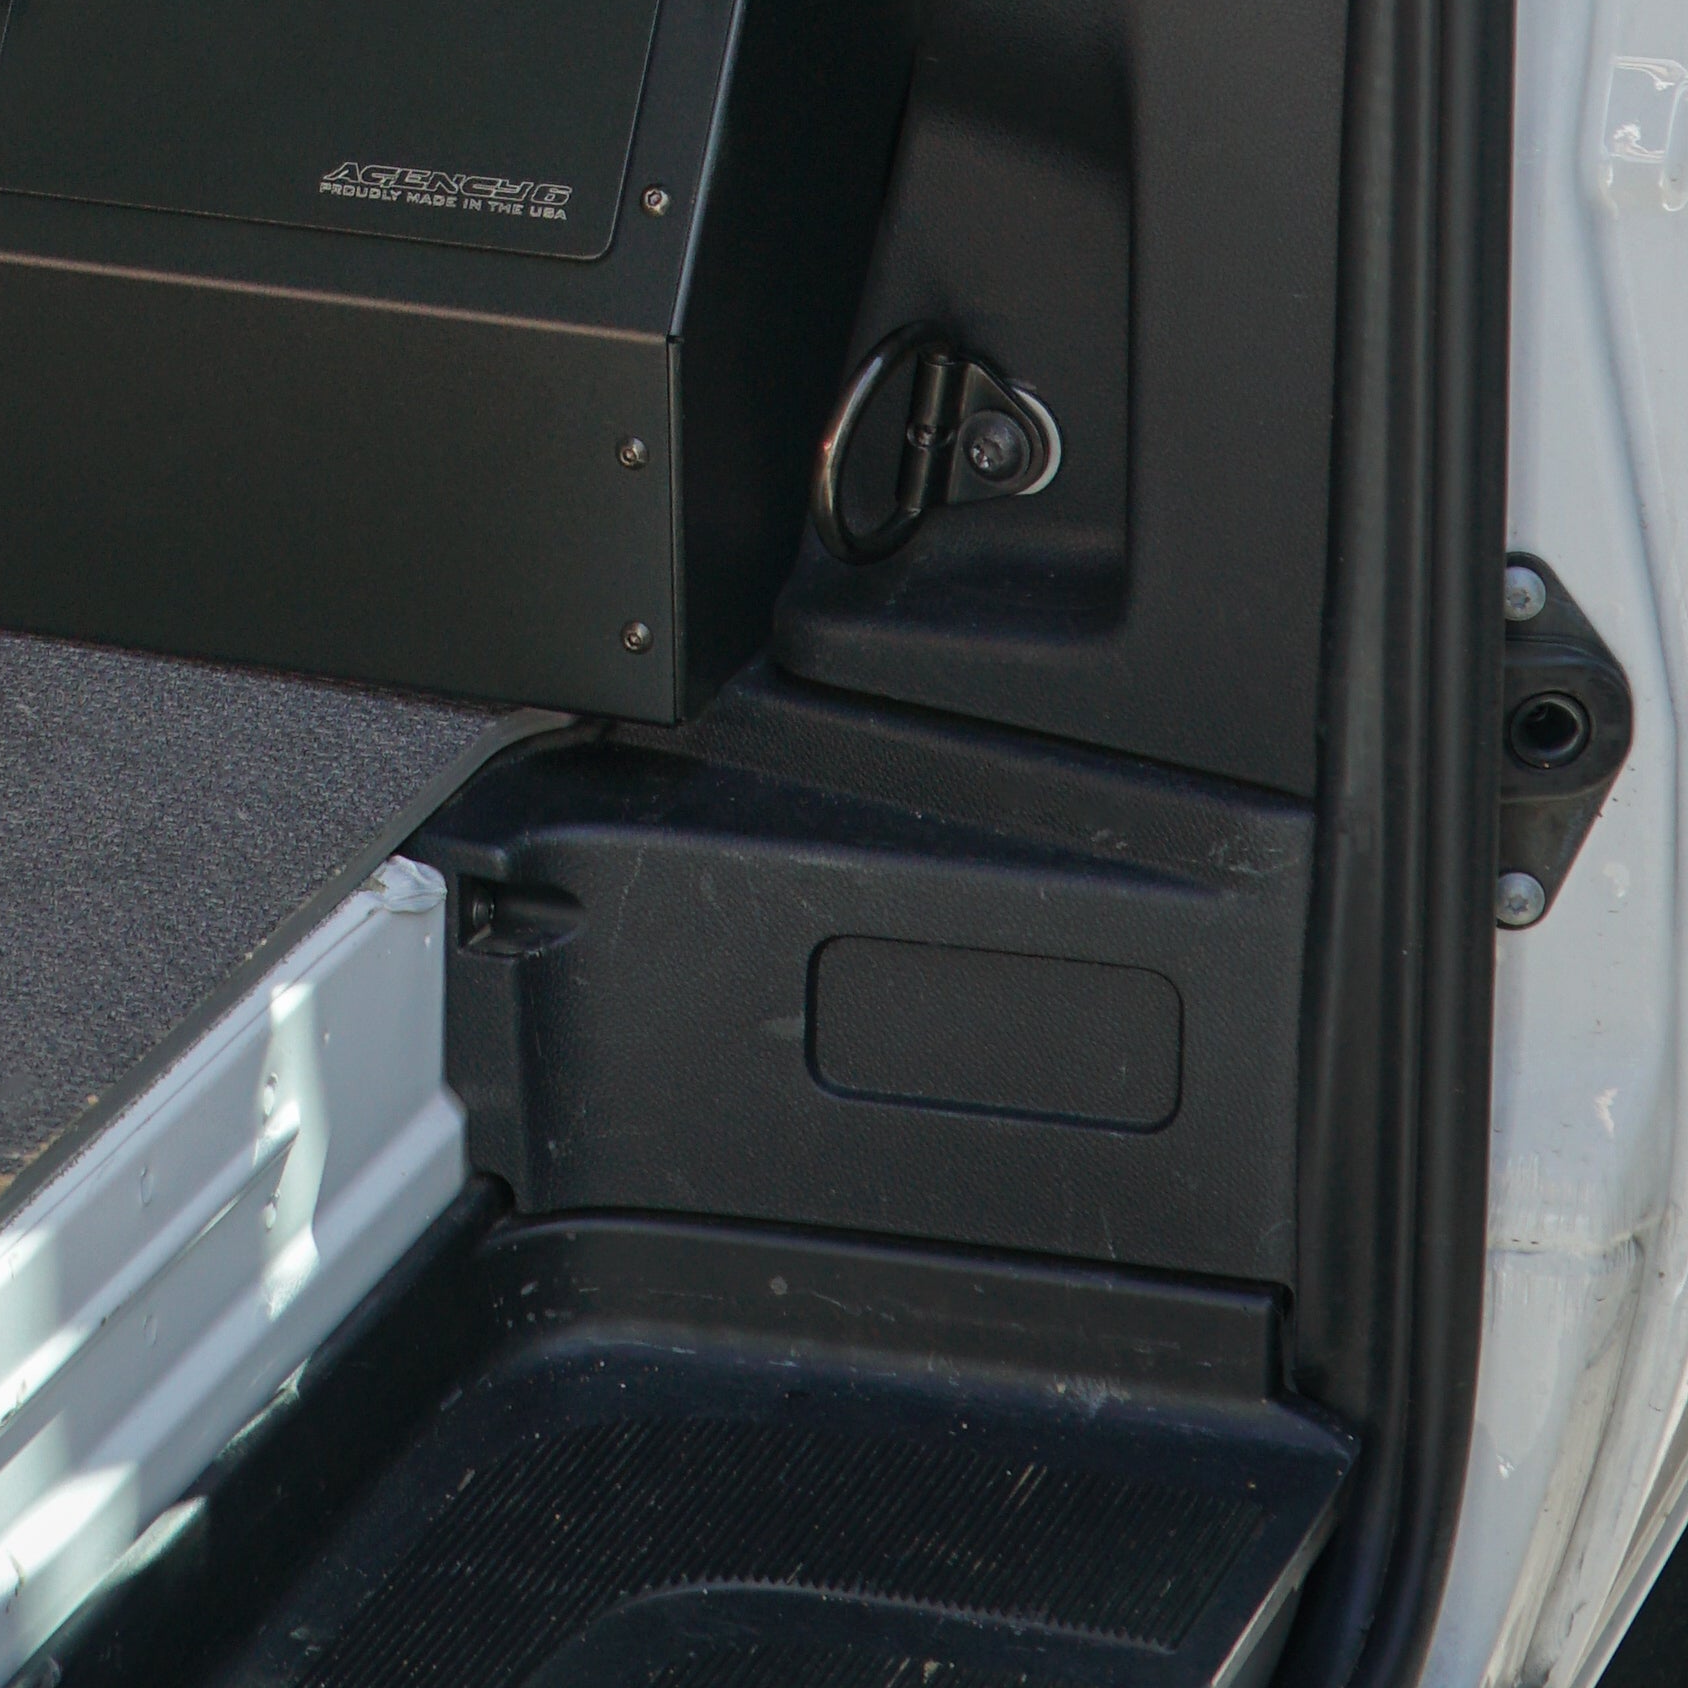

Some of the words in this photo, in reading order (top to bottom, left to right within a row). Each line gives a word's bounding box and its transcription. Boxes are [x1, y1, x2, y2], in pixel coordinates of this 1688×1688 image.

[319, 182, 402, 202] PROUDLY
[407, 192, 457, 208] MADE
[463, 198, 482, 211] IN
[487, 200, 523, 215] THE
[529, 205, 567, 220] USA
